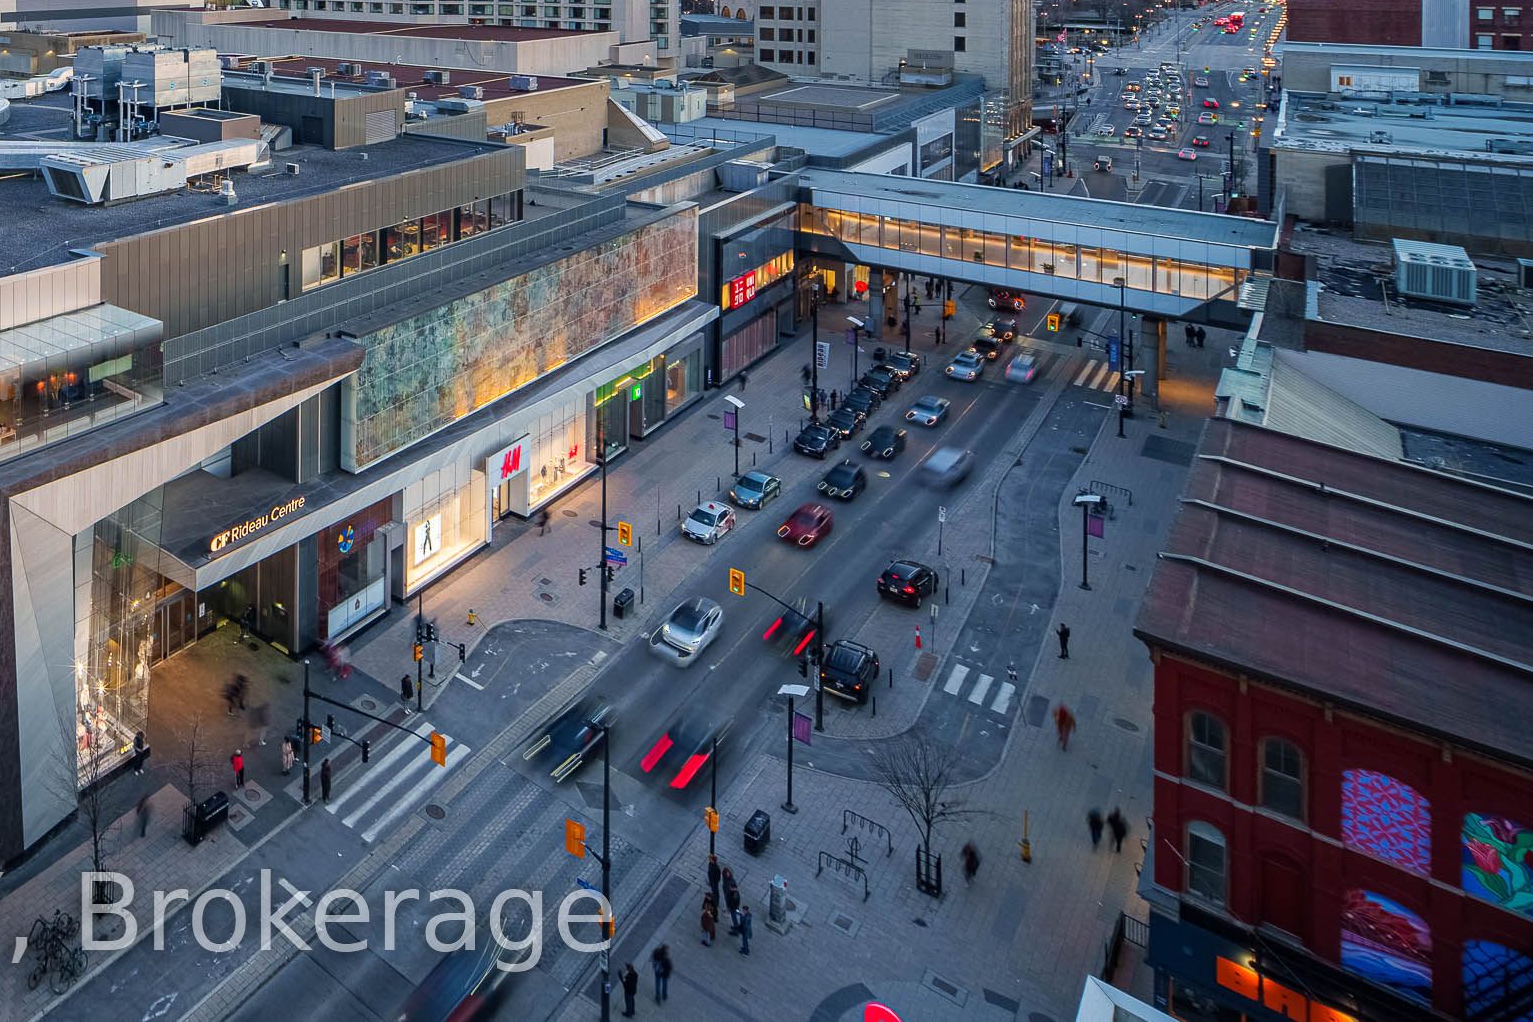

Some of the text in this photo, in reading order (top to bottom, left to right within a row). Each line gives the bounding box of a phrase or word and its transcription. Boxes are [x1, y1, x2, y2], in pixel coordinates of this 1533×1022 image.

[501, 444, 522, 479] H&M
[210, 497, 306, 552] CF Rideau Centre
